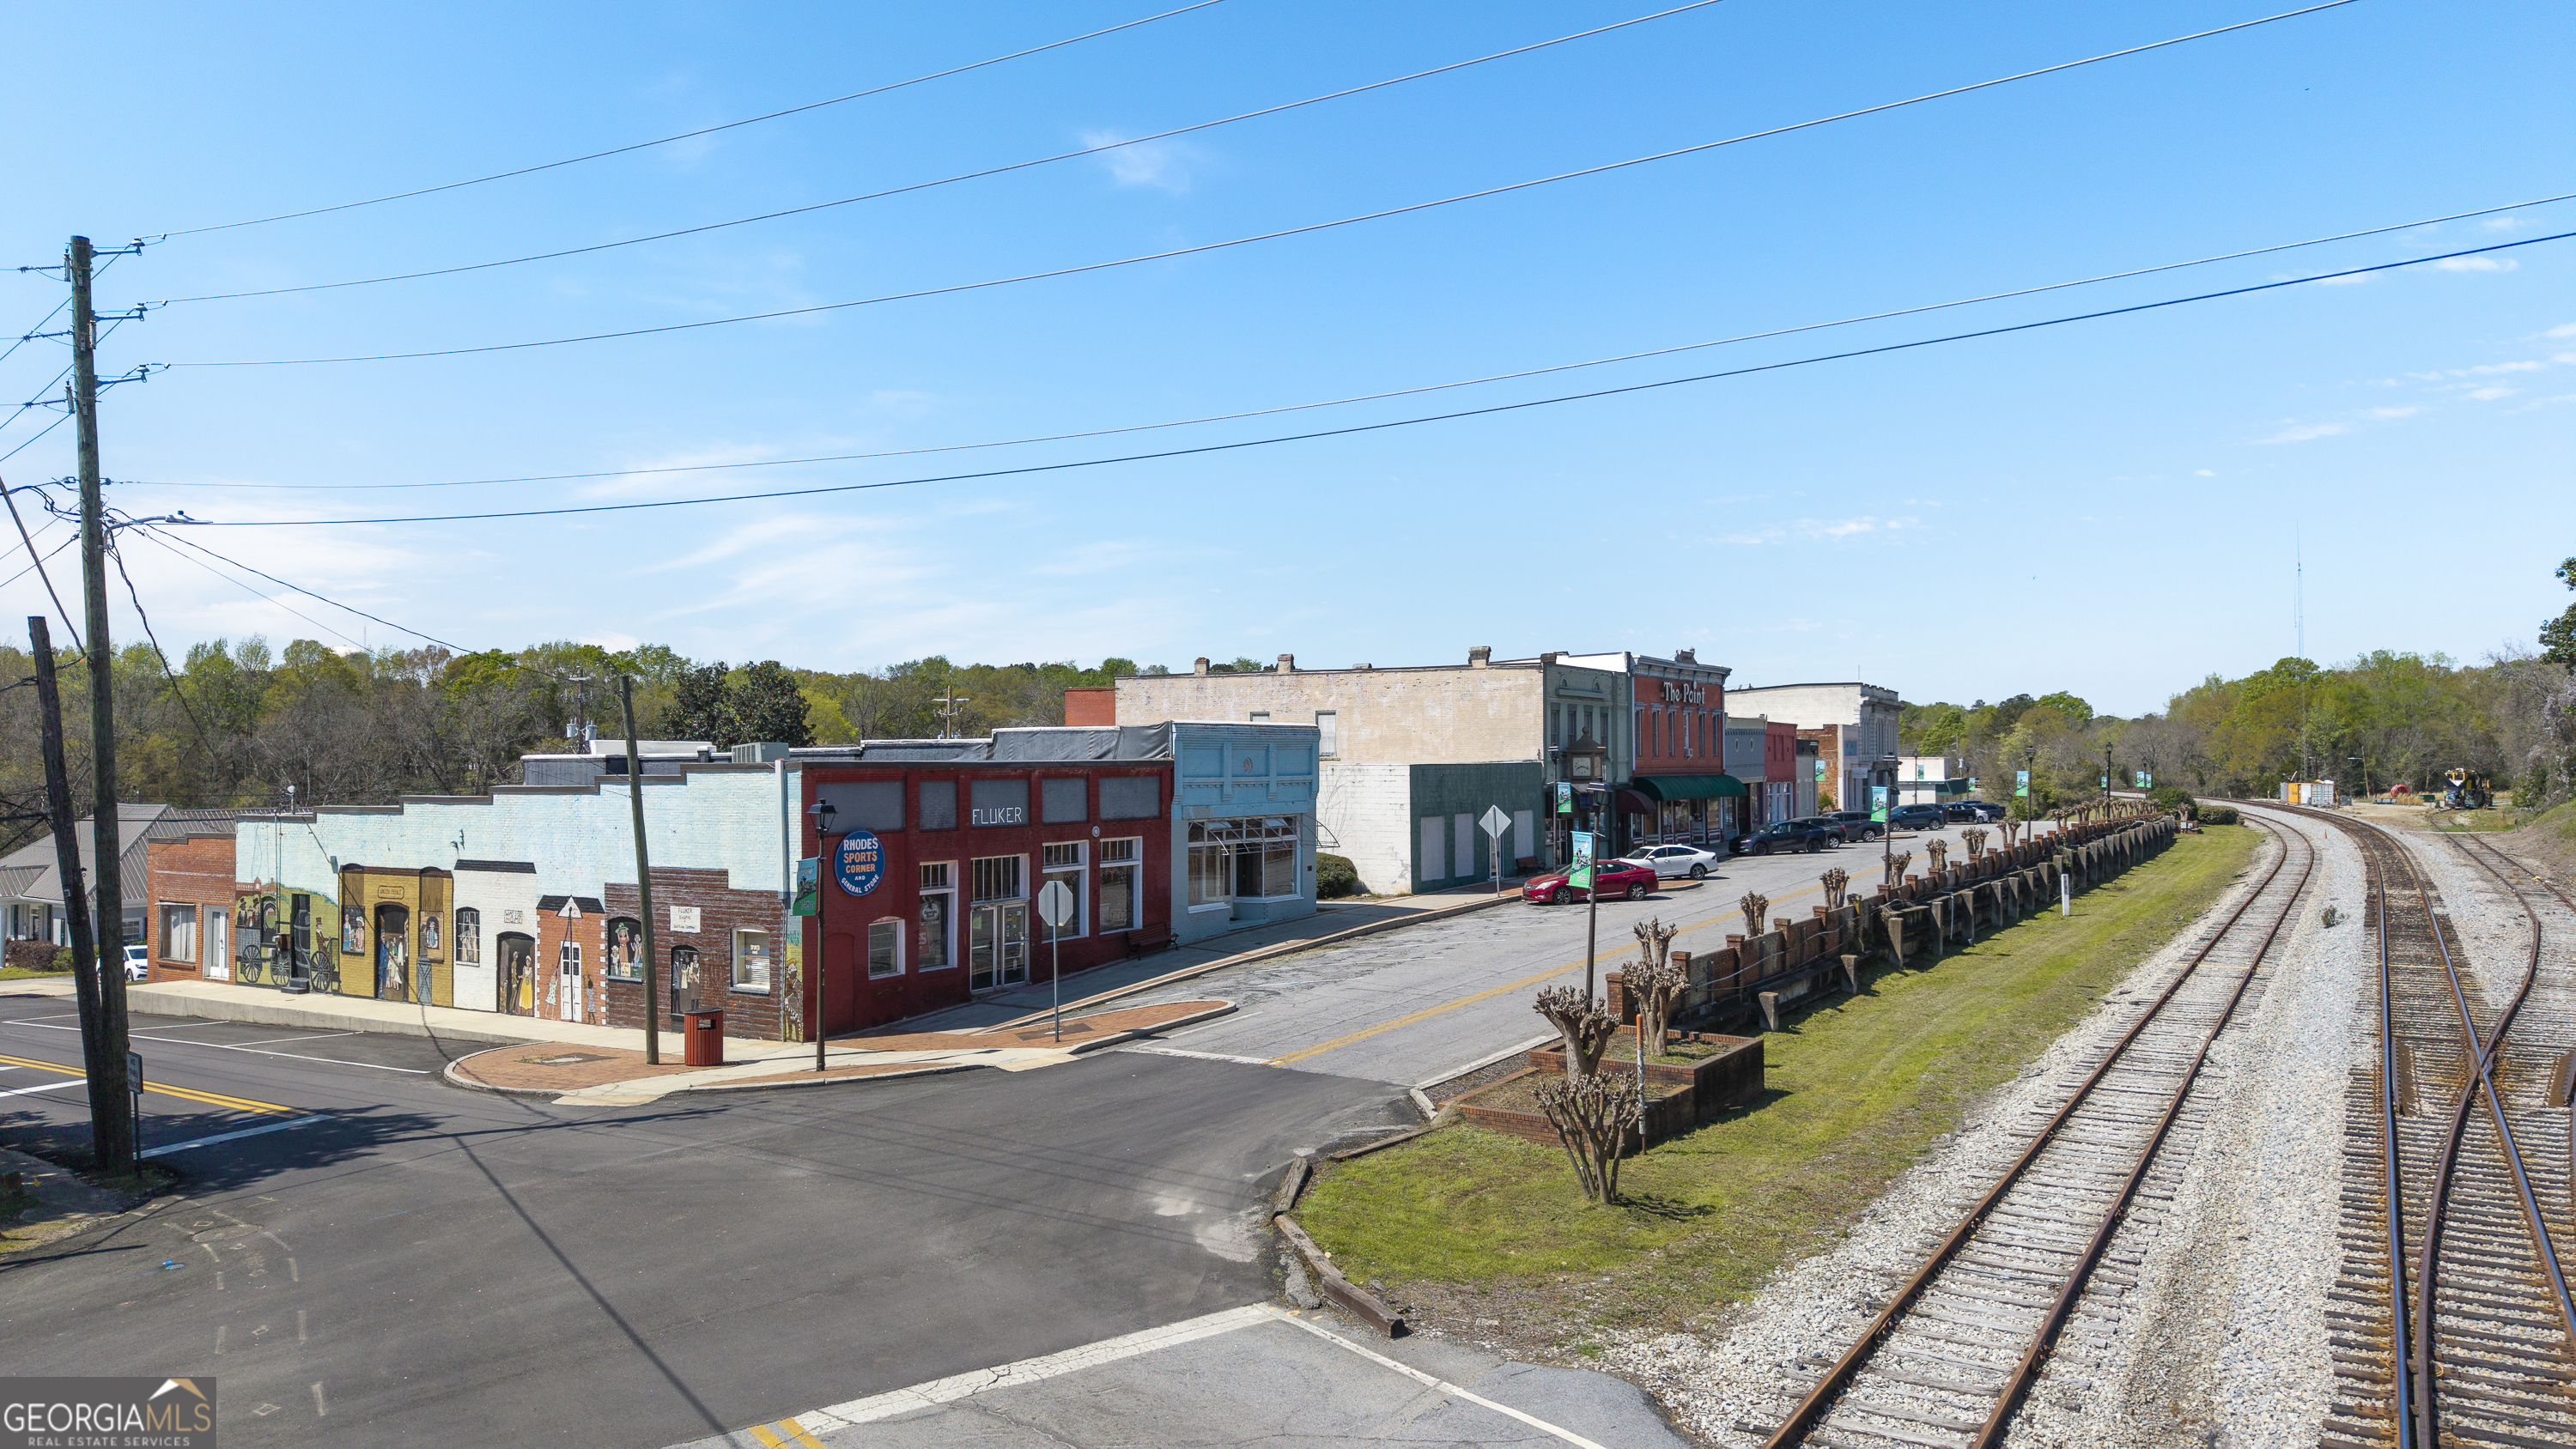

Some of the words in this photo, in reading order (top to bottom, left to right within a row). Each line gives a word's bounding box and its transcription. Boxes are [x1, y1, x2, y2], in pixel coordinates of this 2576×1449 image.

[1663, 682, 1680, 704] The
[1683, 681, 1705, 706] Point
[972, 807, 1022, 825] FLUKER
[843, 838, 878, 851] RHODES
[843, 851, 878, 864] SPORTS
[846, 864, 876, 874] CORNER
[841, 877, 862, 894] GENERAL
[864, 874, 879, 892] STORE
